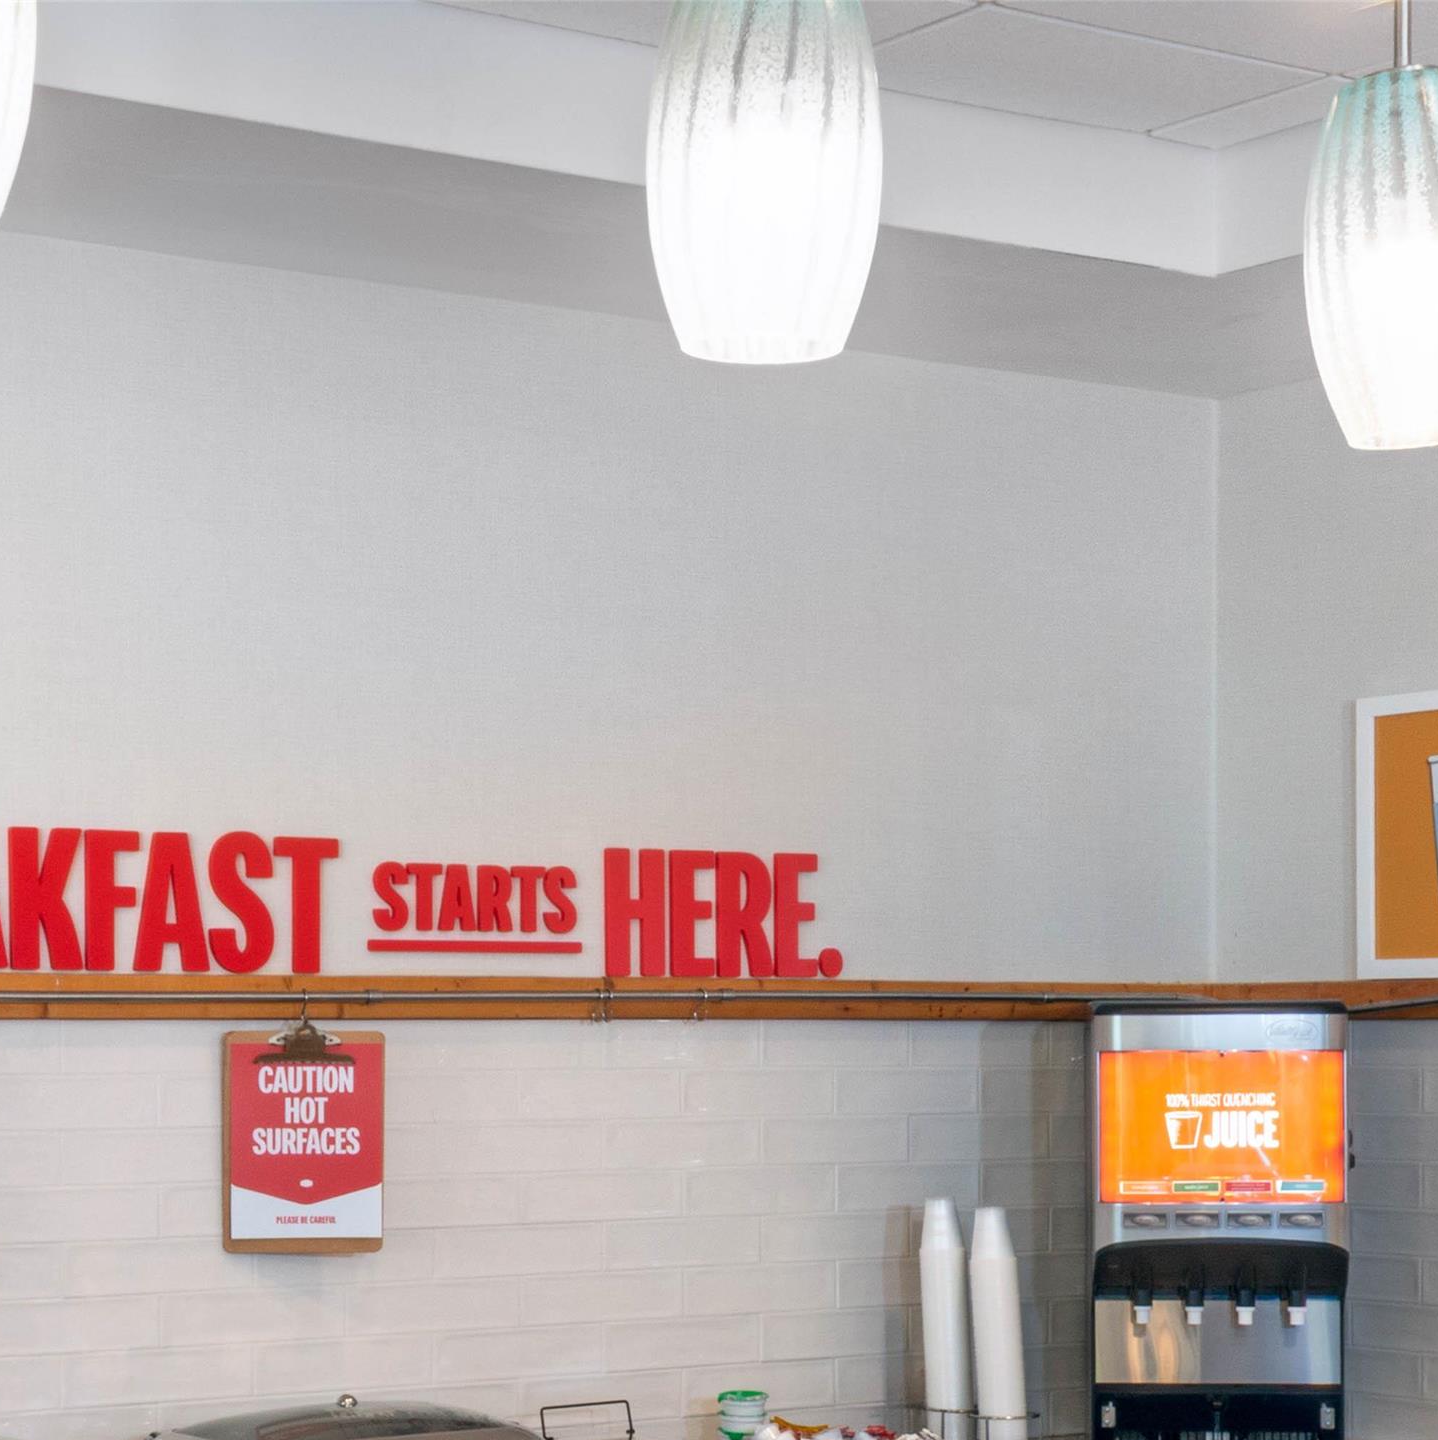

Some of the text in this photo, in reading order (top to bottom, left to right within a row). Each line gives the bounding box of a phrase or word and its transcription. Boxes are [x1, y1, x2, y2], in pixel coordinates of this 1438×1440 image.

[372, 861, 578, 934] STARTS
[604, 847, 843, 977] HERE.
[258, 1065, 354, 1093] CAUTION
[284, 1097, 328, 1124] HOT
[252, 1127, 361, 1155] SURFACES
[1203, 1110, 1280, 1148] JUICE
